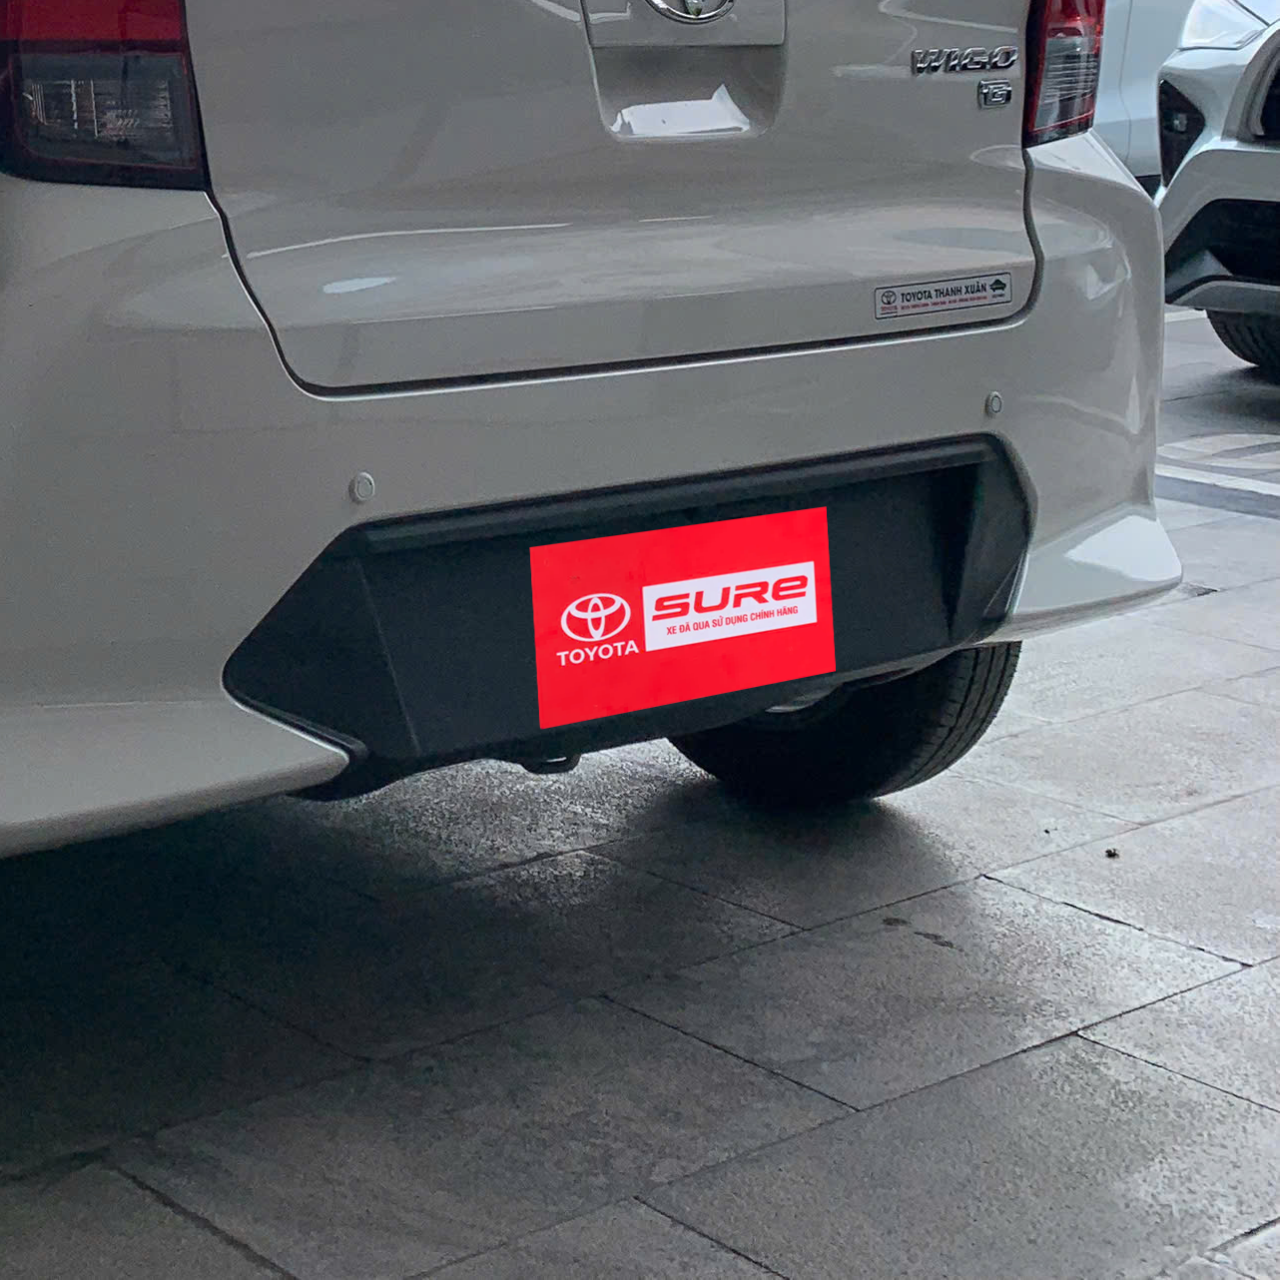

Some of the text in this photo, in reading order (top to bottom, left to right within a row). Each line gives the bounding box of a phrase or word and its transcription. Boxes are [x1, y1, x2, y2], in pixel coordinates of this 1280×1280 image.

[912, 46, 1019, 74] WIGO
[901, 290, 933, 303] TOYOTA
[934, 285, 963, 298] THANH
[964, 281, 987, 295] XUÂN
[666, 606, 798, 636] XE ĐÃ QUA SỬ DỤNG CHÍNH HÃNG
[556, 639, 640, 667] TOYOTA
